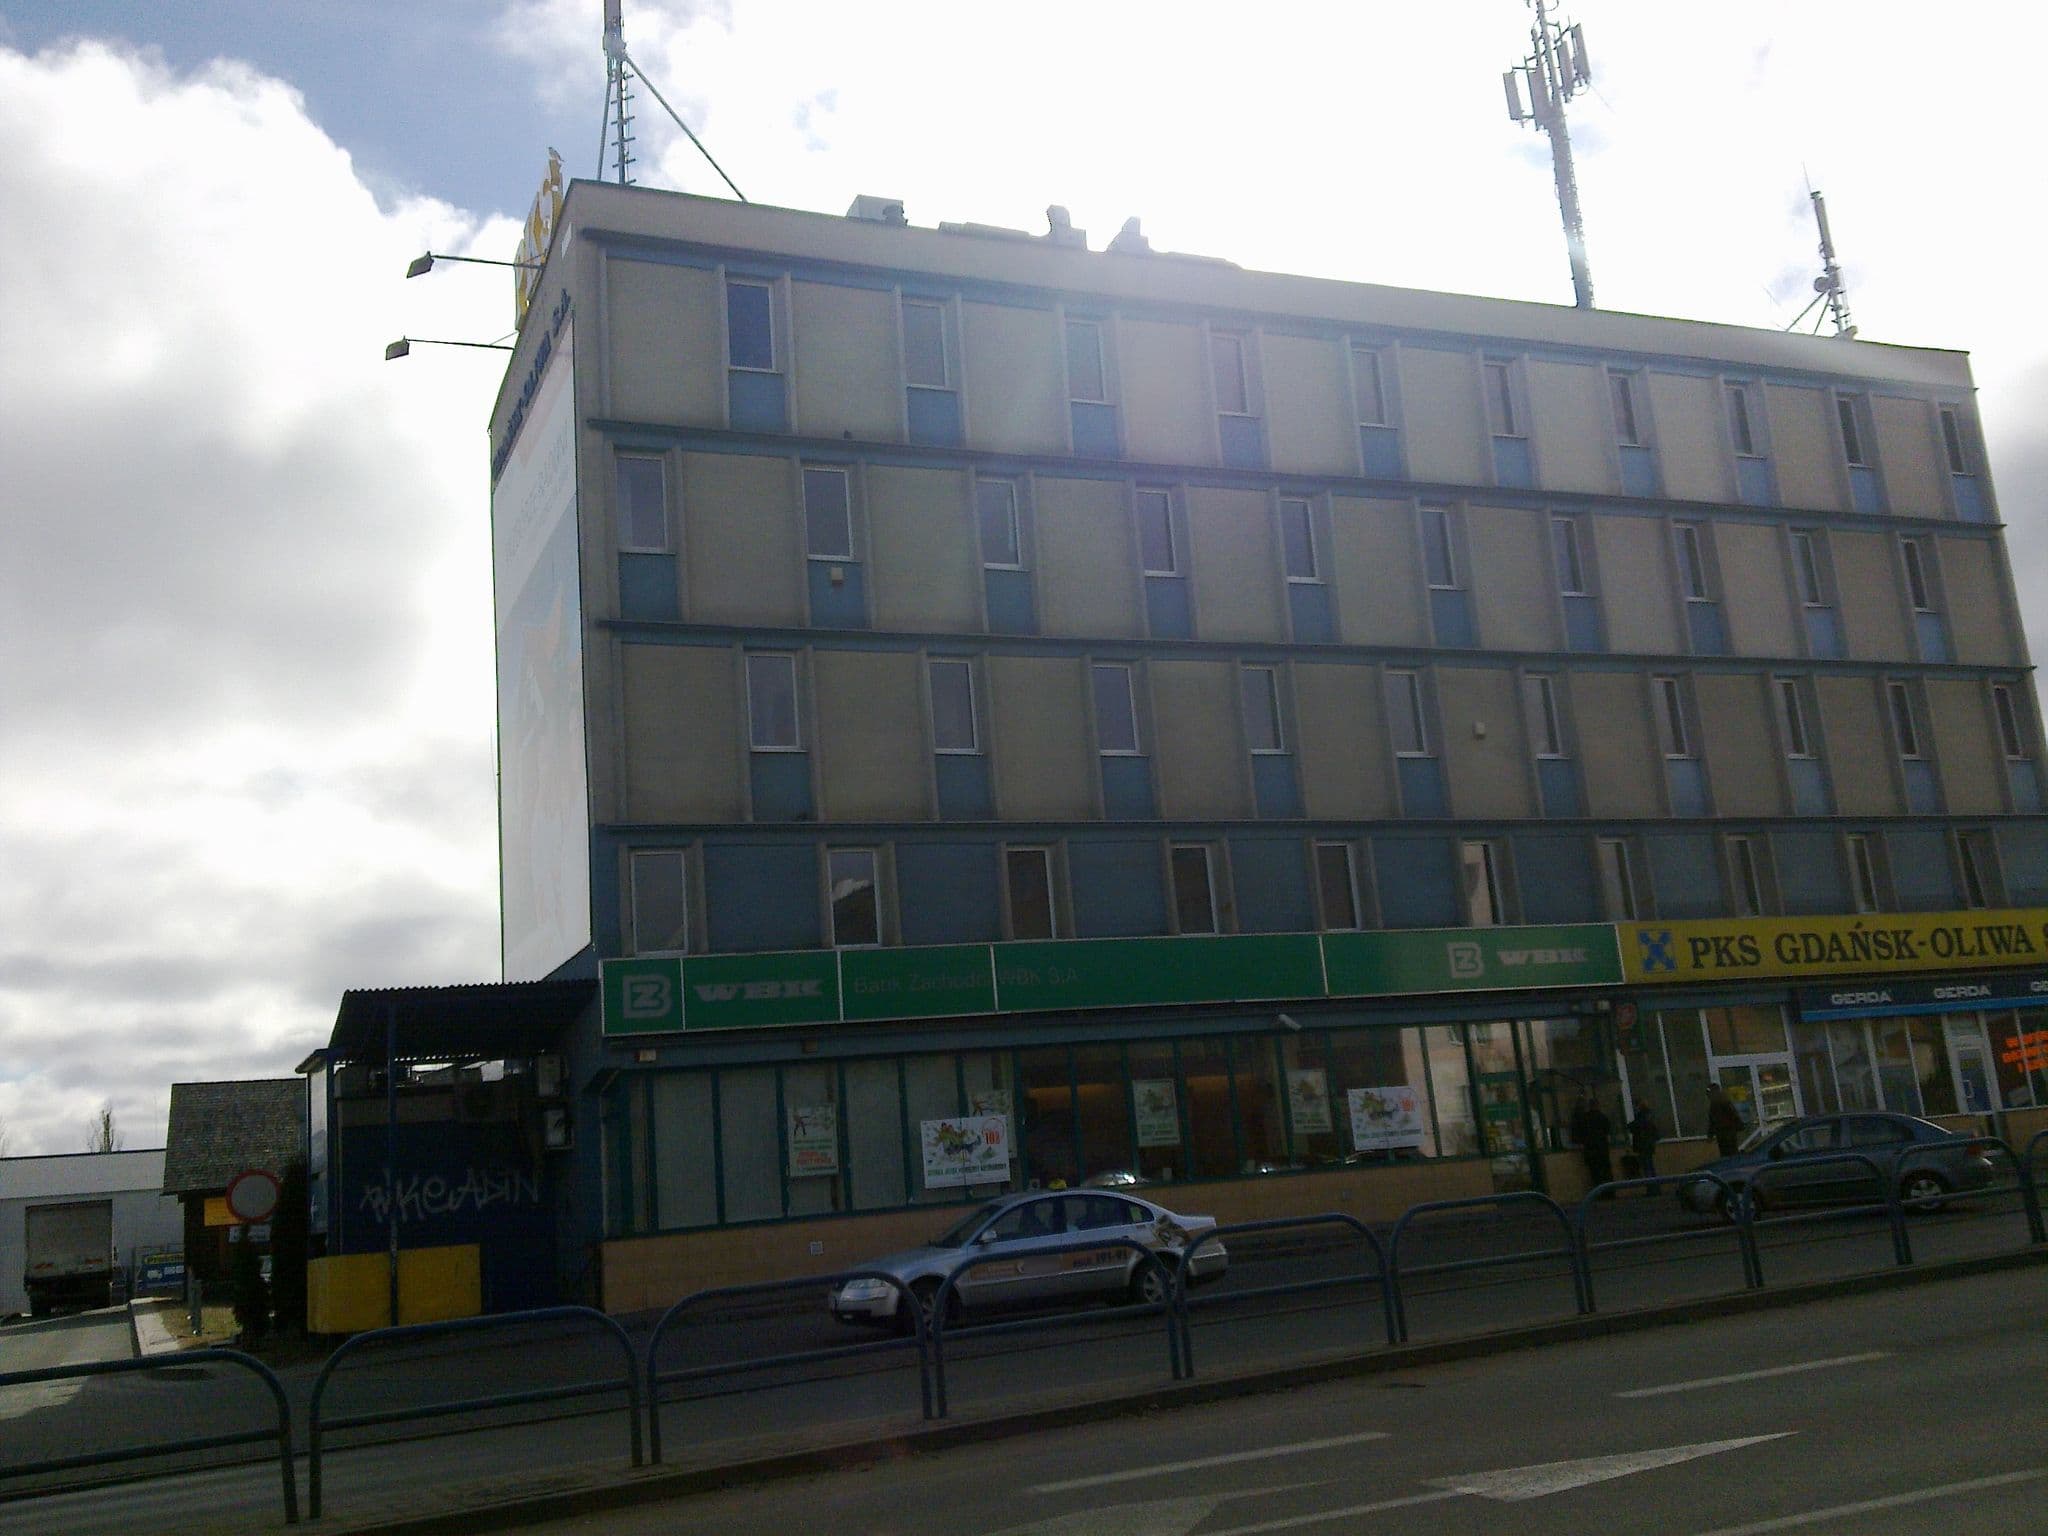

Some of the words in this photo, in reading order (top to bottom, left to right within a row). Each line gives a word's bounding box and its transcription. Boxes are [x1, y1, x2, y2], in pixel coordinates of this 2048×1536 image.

[1688, 935, 1762, 969] PKS
[1775, 921, 2037, 965] GDAŃSK-OLIWA
[1497, 949, 1588, 967] WBK
[692, 979, 825, 1003] WBK
[1831, 990, 1893, 1005] GERDA
[1934, 984, 1992, 1000] GERDA
